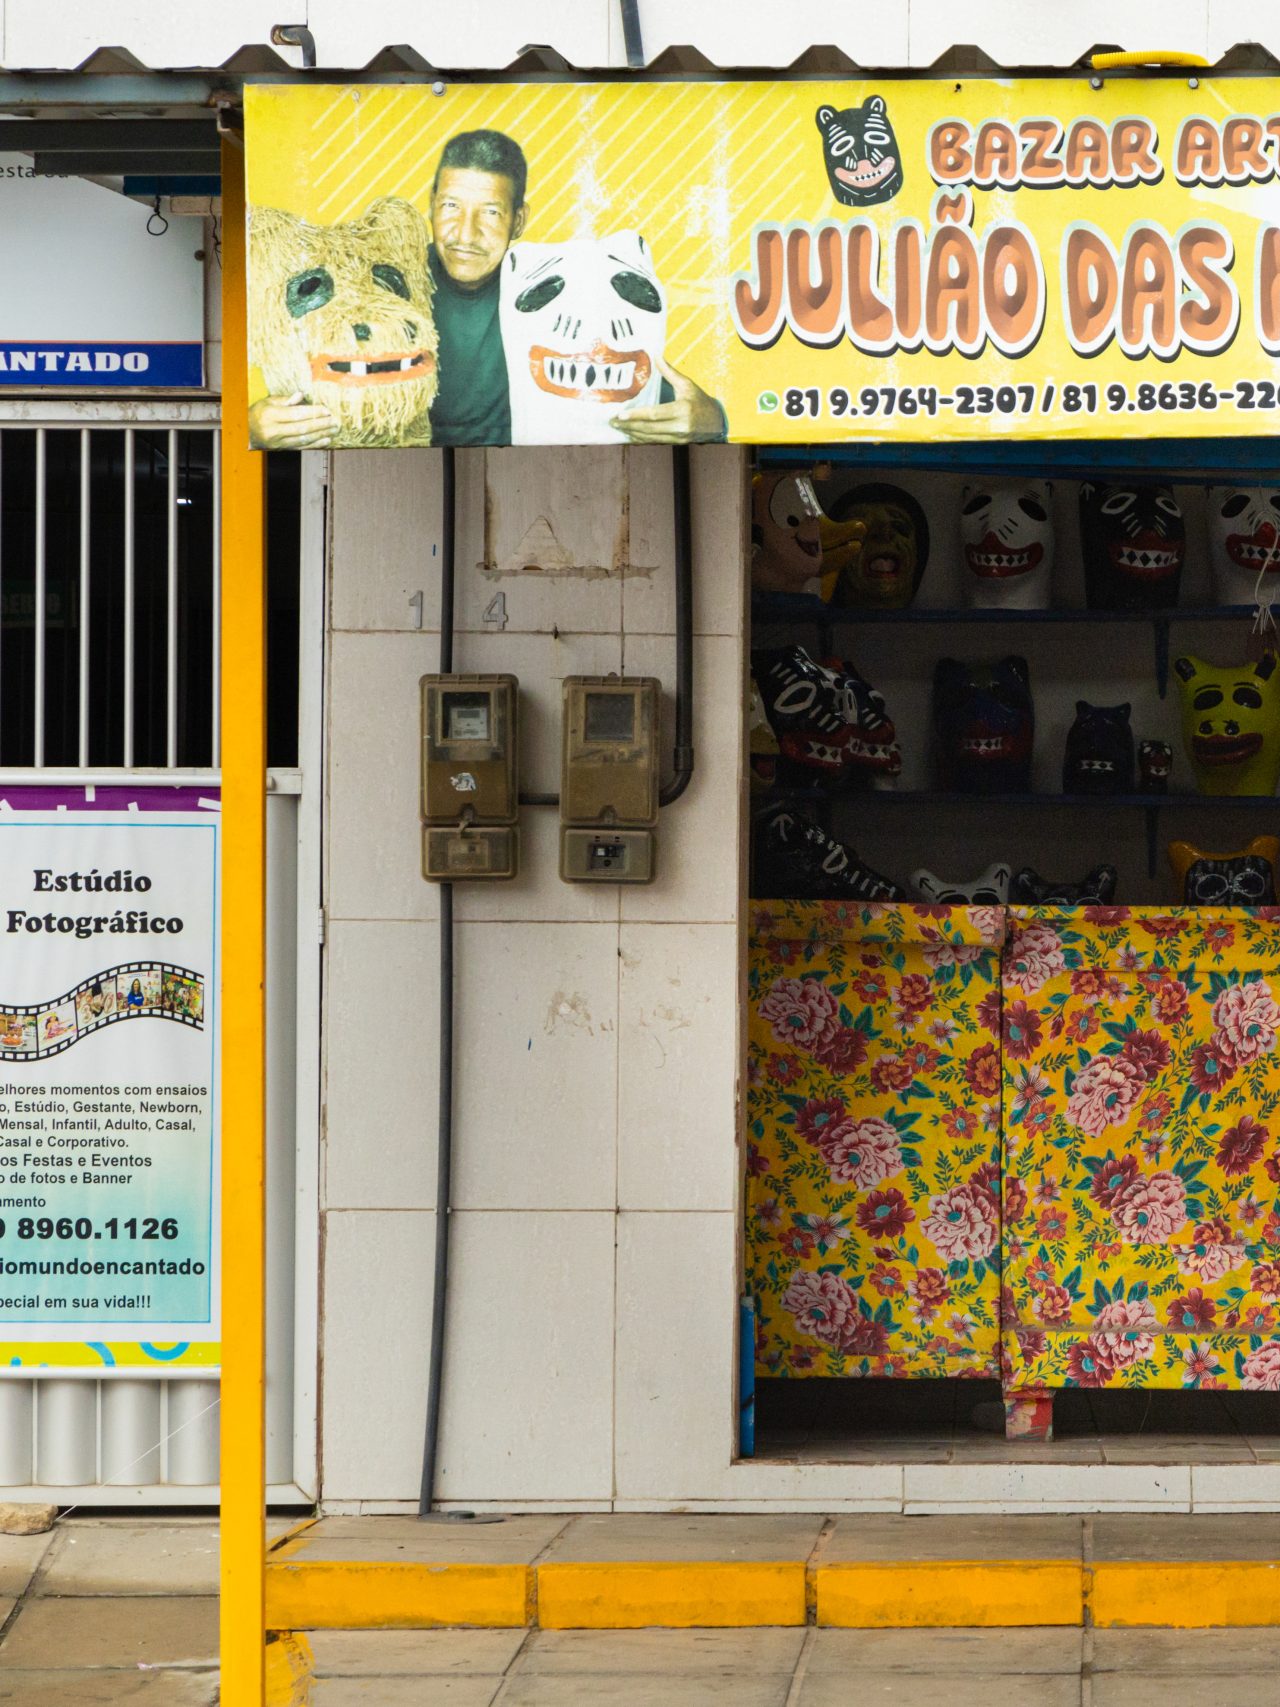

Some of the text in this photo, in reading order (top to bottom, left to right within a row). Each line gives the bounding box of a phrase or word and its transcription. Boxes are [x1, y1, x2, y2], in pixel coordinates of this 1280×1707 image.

[929, 117, 1162, 189] BAZAR
[732, 186, 1045, 359] JULIÃO
[1062, 219, 1241, 362] DAS
[785, 388, 820, 417] 81
[829, 385, 1035, 417] 9.9764-2307
[1063, 383, 1097, 413] 81
[33, 869, 152, 892] Estúdio
[6, 910, 184, 938] Fotográfico
[50, 1084, 120, 1096] momentos
[124, 1086, 152, 1096] com
[155, 1084, 207, 1096] ensaios
[14, 1101, 69, 1115] Estúdio,
[73, 1101, 135, 1115] Gestante,
[139, 1101, 202, 1116] Newborn,
[51, 1118, 100, 1132] Infantil,
[104, 1118, 151, 1132] Adulto,
[155, 1119, 196, 1133] Casal,
[35, 1139, 43, 1148] e
[47, 1136, 129, 1151] Corporativo.
[23, 1154, 73, 1167] Festas
[77, 1157, 86, 1167] e
[91, 1154, 152, 1168] Eventos
[9, 1172, 26, 1184] de
[30, 1172, 66, 1184] fotos
[70, 1175, 78, 1184] e
[82, 1172, 132, 1184] Banner
[0, 1196, 46, 1208] mento
[17, 1217, 179, 1240] 8960.1126
[44, 1298, 67, 1309] em
[72, 1298, 99, 1309] sua
[104, 1295, 151, 1309] vida!!!
